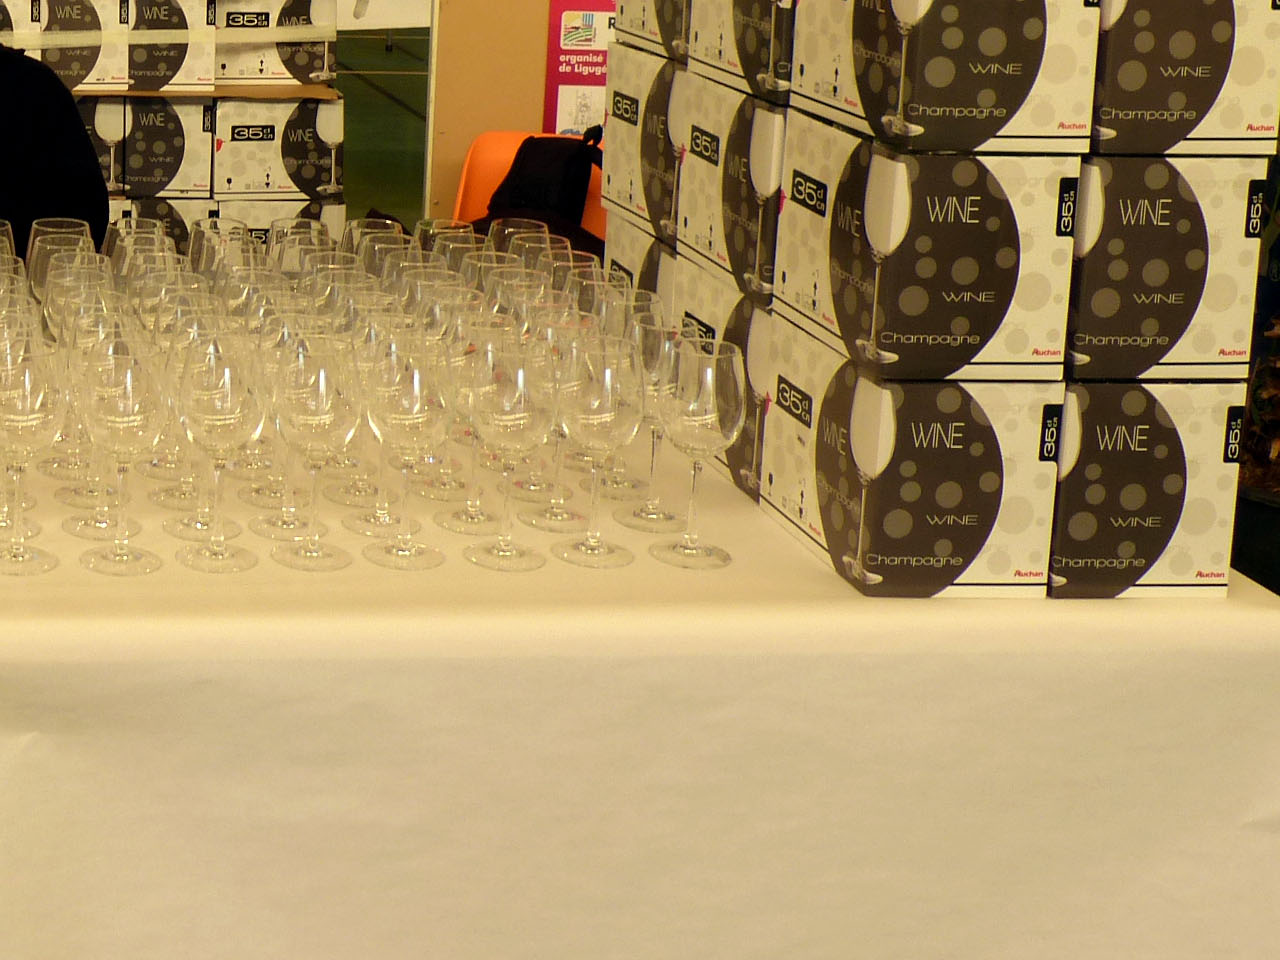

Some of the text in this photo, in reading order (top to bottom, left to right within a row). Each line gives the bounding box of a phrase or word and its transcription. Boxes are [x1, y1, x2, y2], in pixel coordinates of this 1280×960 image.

[56, 5, 82, 19] WINE
[143, 6, 169, 20] WINE
[559, 53, 603, 65] organisé
[559, 64, 572, 73] de
[969, 62, 1023, 75] WINE
[1160, 66, 1212, 78] WINE
[907, 104, 1006, 119] Champagne
[1100, 107, 1196, 122] Champagne
[139, 112, 165, 127] WINE
[1057, 122, 1087, 130] Auchan
[1246, 124, 1275, 132] Auchan
[288, 128, 313, 142] WINE
[926, 196, 982, 223] WINE
[1119, 199, 1173, 226] WINE
[837, 201, 862, 237] WINE
[942, 291, 996, 303] WINE
[1133, 293, 1185, 305] WINE
[880, 331, 980, 347] Champagne
[1074, 334, 1169, 348] Champagne
[1032, 348, 1061, 357] Auchan
[1218, 348, 1247, 357] Auchan
[823, 416, 848, 455] WINE
[911, 422, 966, 449] WINE
[1096, 425, 1150, 452] WINE
[926, 514, 979, 526] WINE
[1110, 517, 1162, 528] WINE
[866, 554, 963, 568] Champagne
[1052, 556, 1146, 569] Champagne
[1014, 569, 1044, 578] Auchan
[1195, 570, 1225, 579] Auchan
